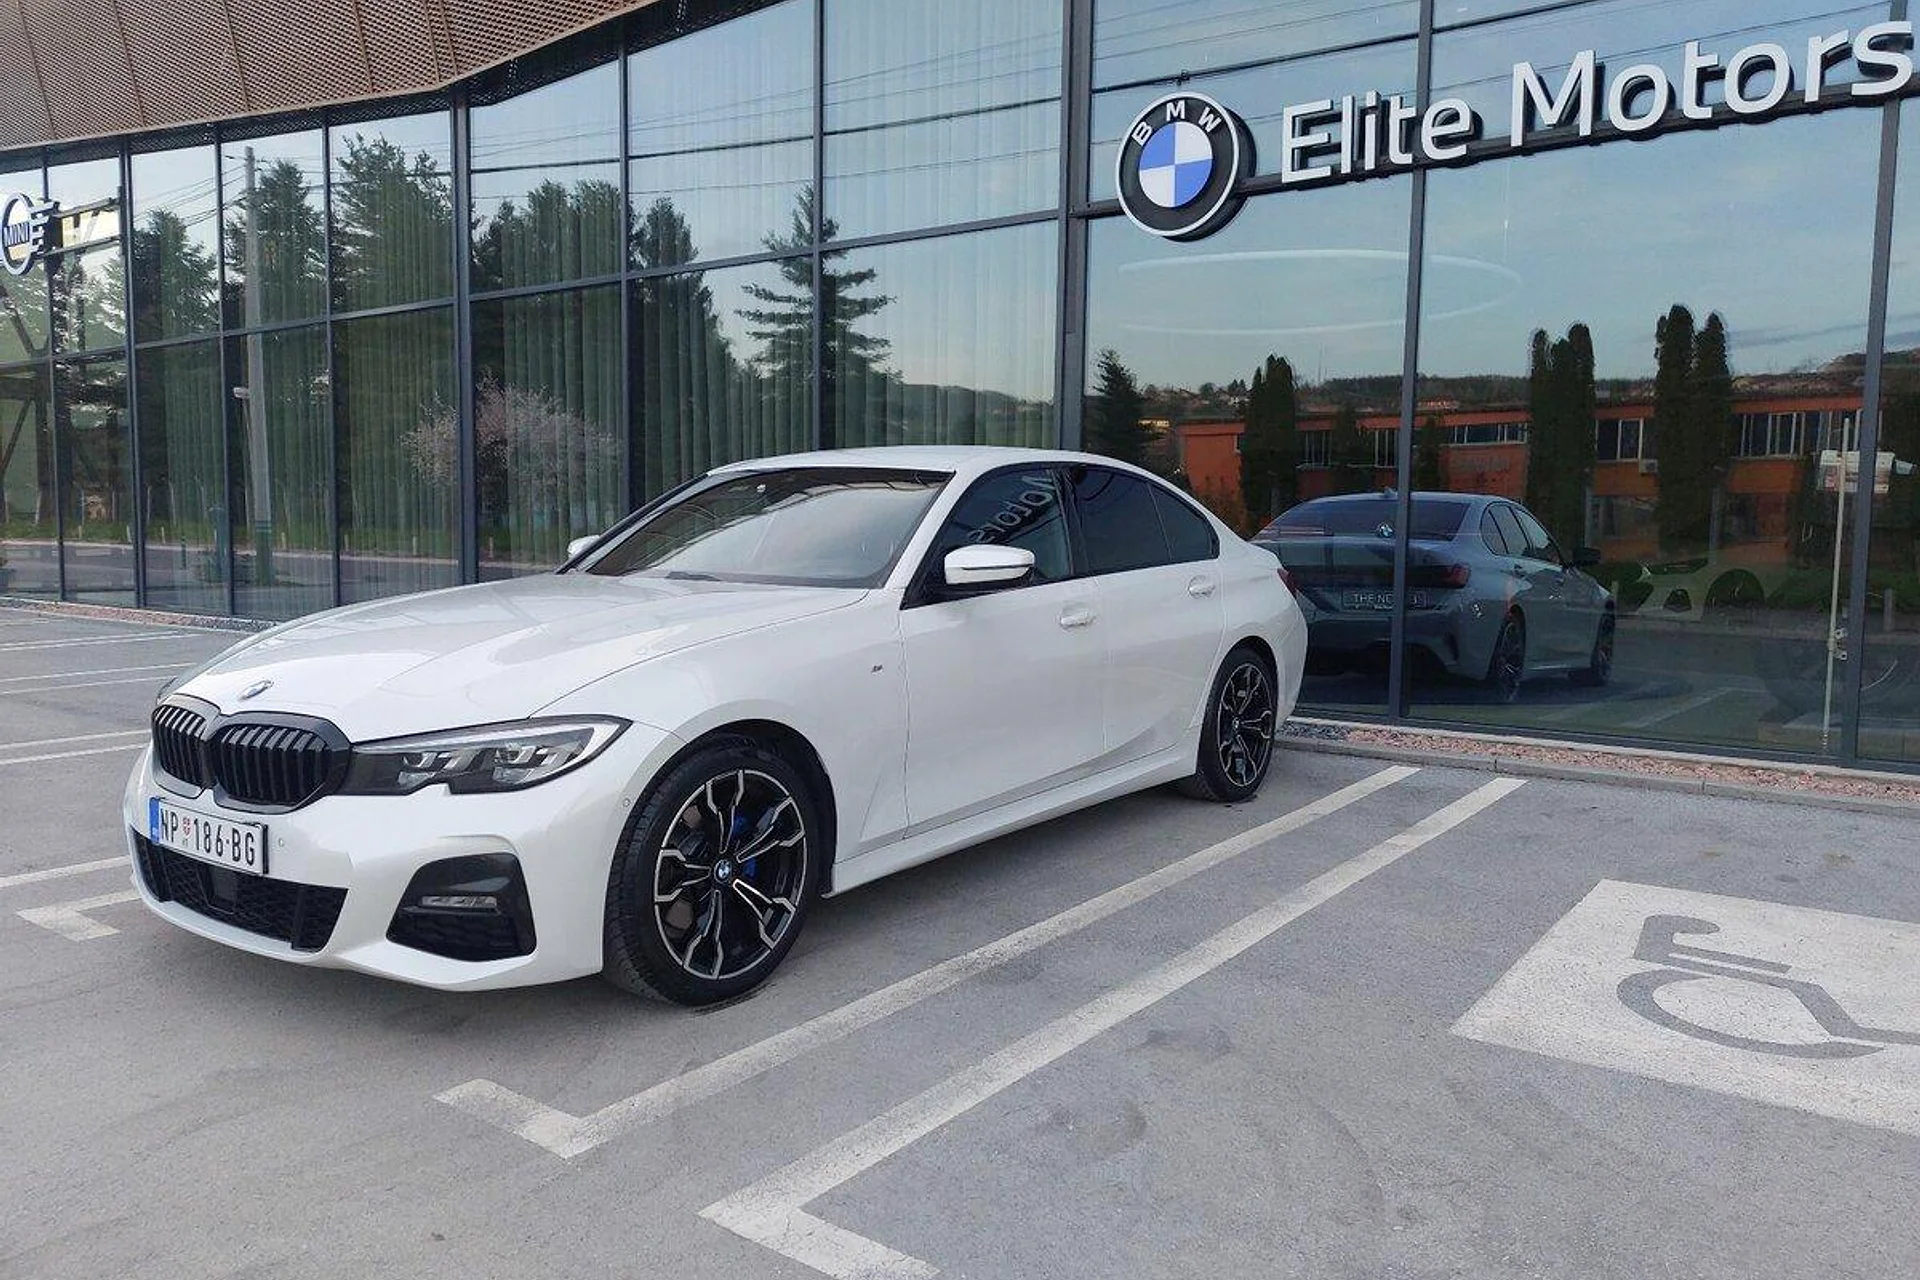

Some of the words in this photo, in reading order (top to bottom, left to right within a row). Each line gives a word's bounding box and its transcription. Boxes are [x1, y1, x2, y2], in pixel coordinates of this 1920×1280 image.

[1132, 99, 1222, 146] BMW
[1281, 93, 1476, 185] Elite
[1510, 20, 1914, 148] Motors
[4, 221, 30, 248] MINI
[160, 808, 179, 842] NP
